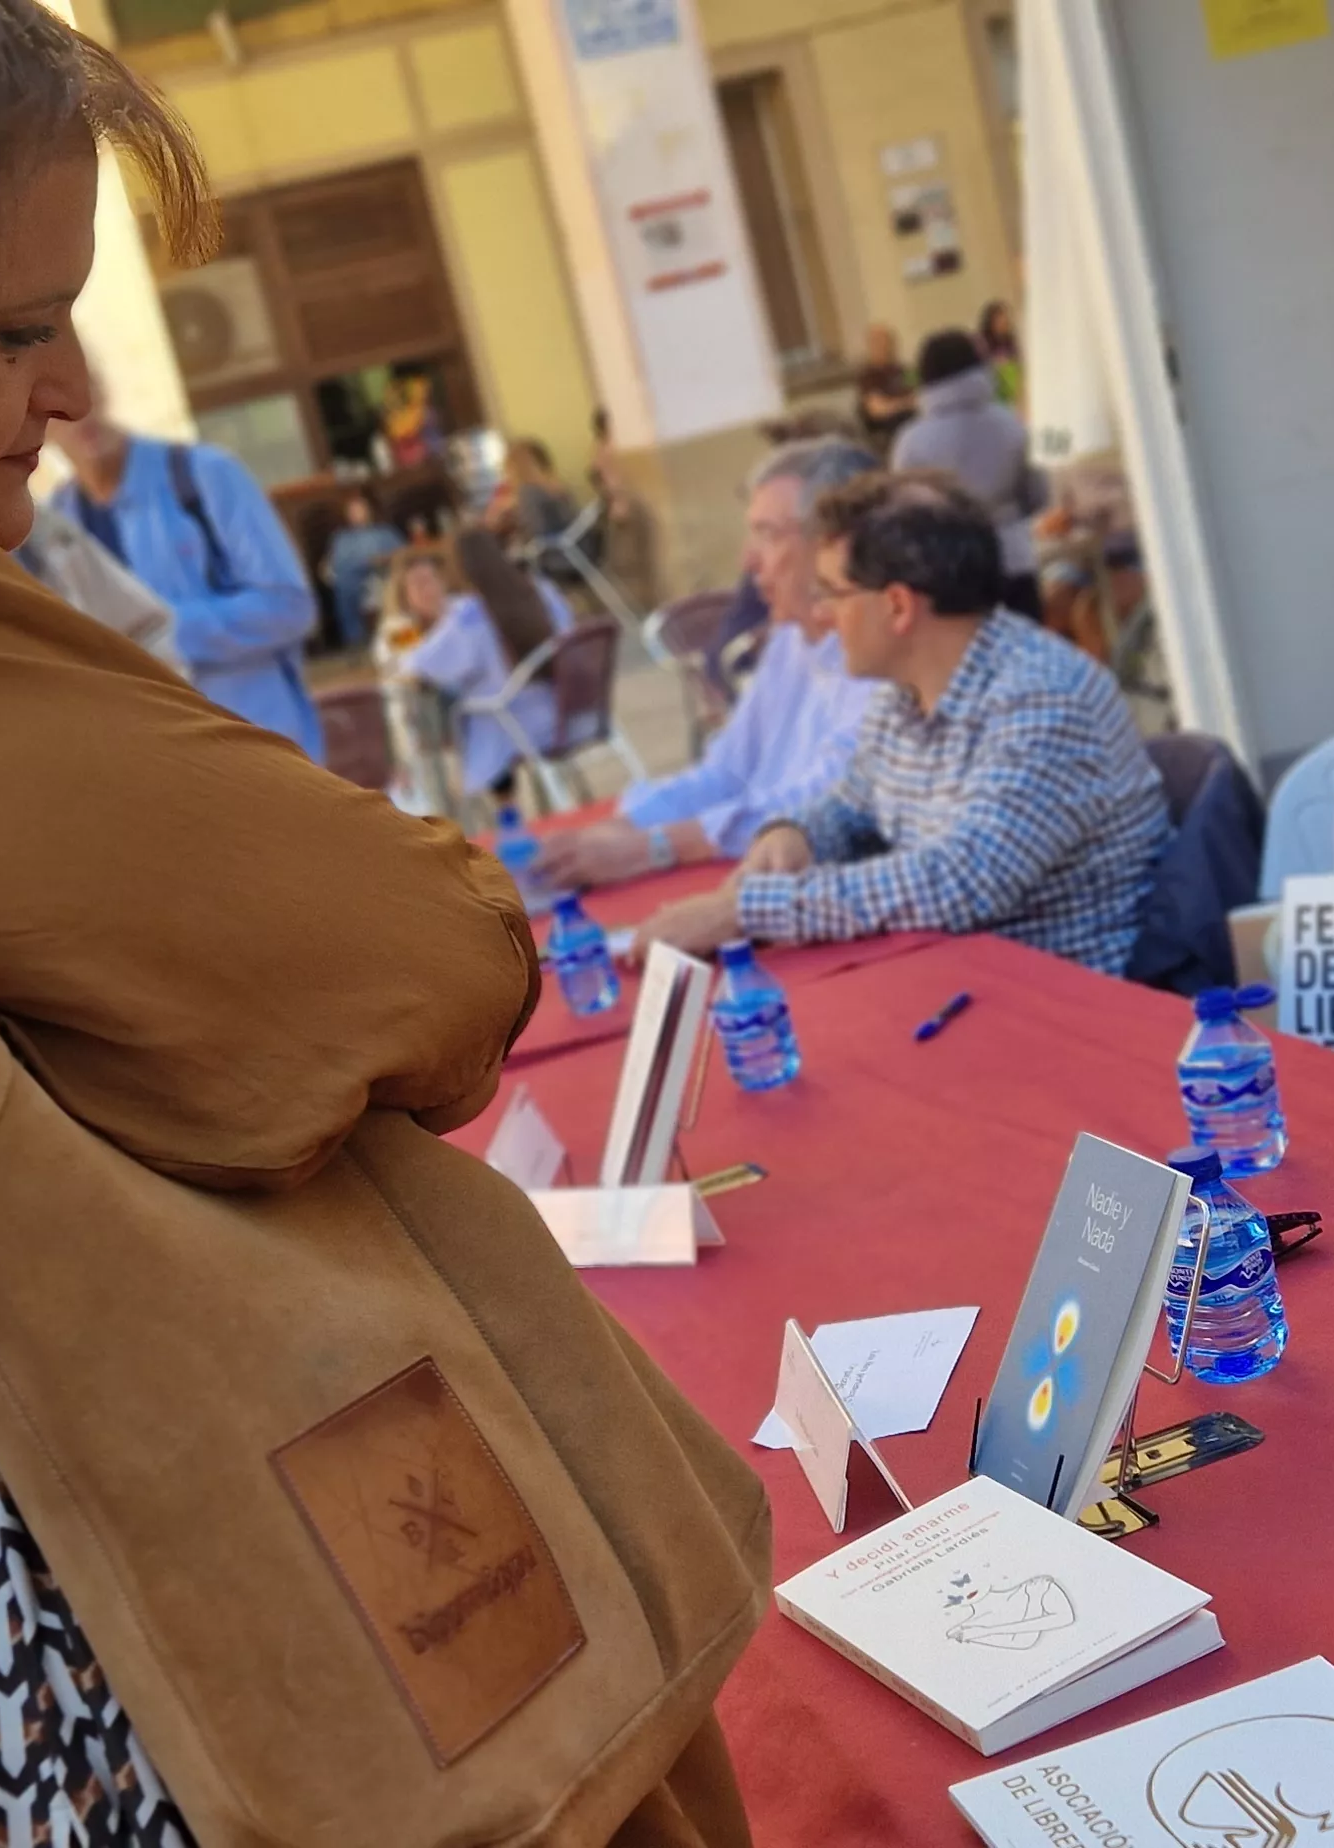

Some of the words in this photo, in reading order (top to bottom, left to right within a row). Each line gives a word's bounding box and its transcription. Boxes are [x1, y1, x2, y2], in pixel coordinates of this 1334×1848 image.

[1085, 1182, 1122, 1221] Nadie
[1118, 1205, 1134, 1231] y
[1081, 1216, 1115, 1254] Nada
[825, 1568, 840, 1581] Y
[902, 1502, 971, 1541] amarme
[873, 1547, 910, 1571] Pilar
[914, 1527, 951, 1549] Clau
[871, 1556, 934, 1593] Gabriela
[1002, 1774, 1037, 1800] DE
[1036, 1763, 1134, 1848] ASOCIACIÓ
